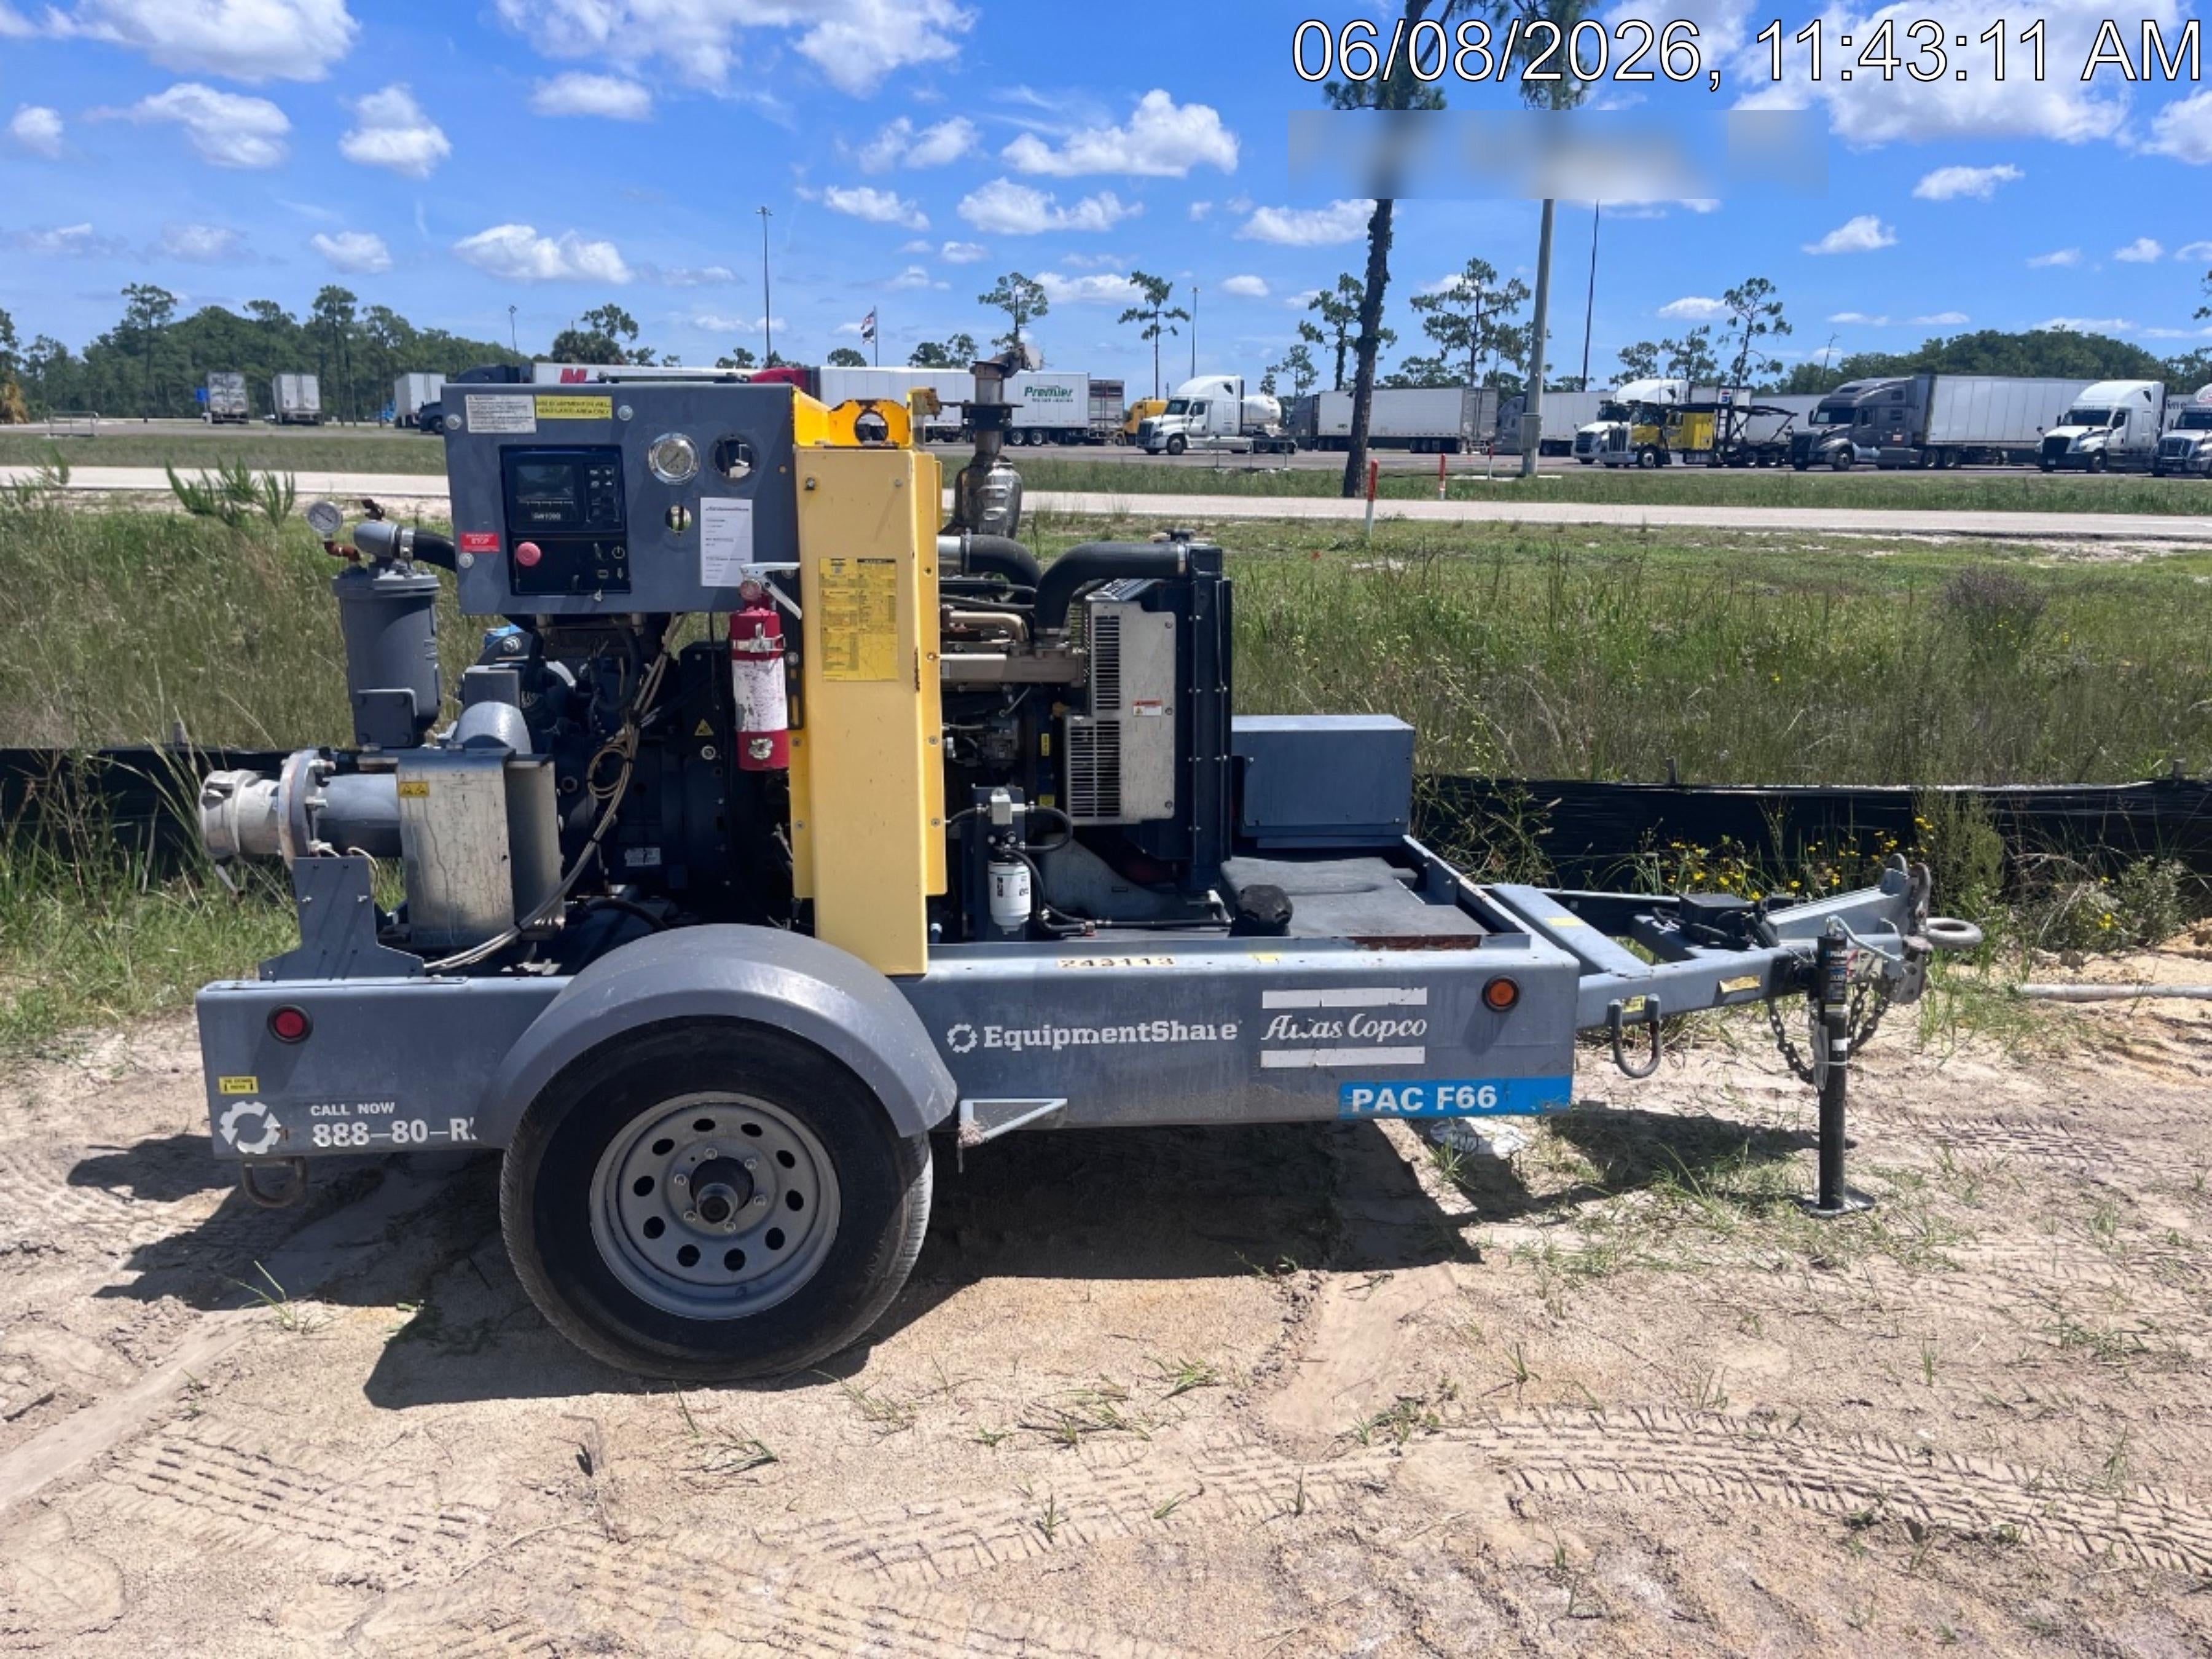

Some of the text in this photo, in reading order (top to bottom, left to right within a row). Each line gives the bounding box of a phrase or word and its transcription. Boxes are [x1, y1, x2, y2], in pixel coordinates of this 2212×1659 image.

[983, 1020, 1237, 1051] EquipmentShare
[1347, 1013, 1427, 1043] Copco
[310, 1102, 395, 1116] CALL NOW
[1352, 1084, 1497, 1112] PAC F66
